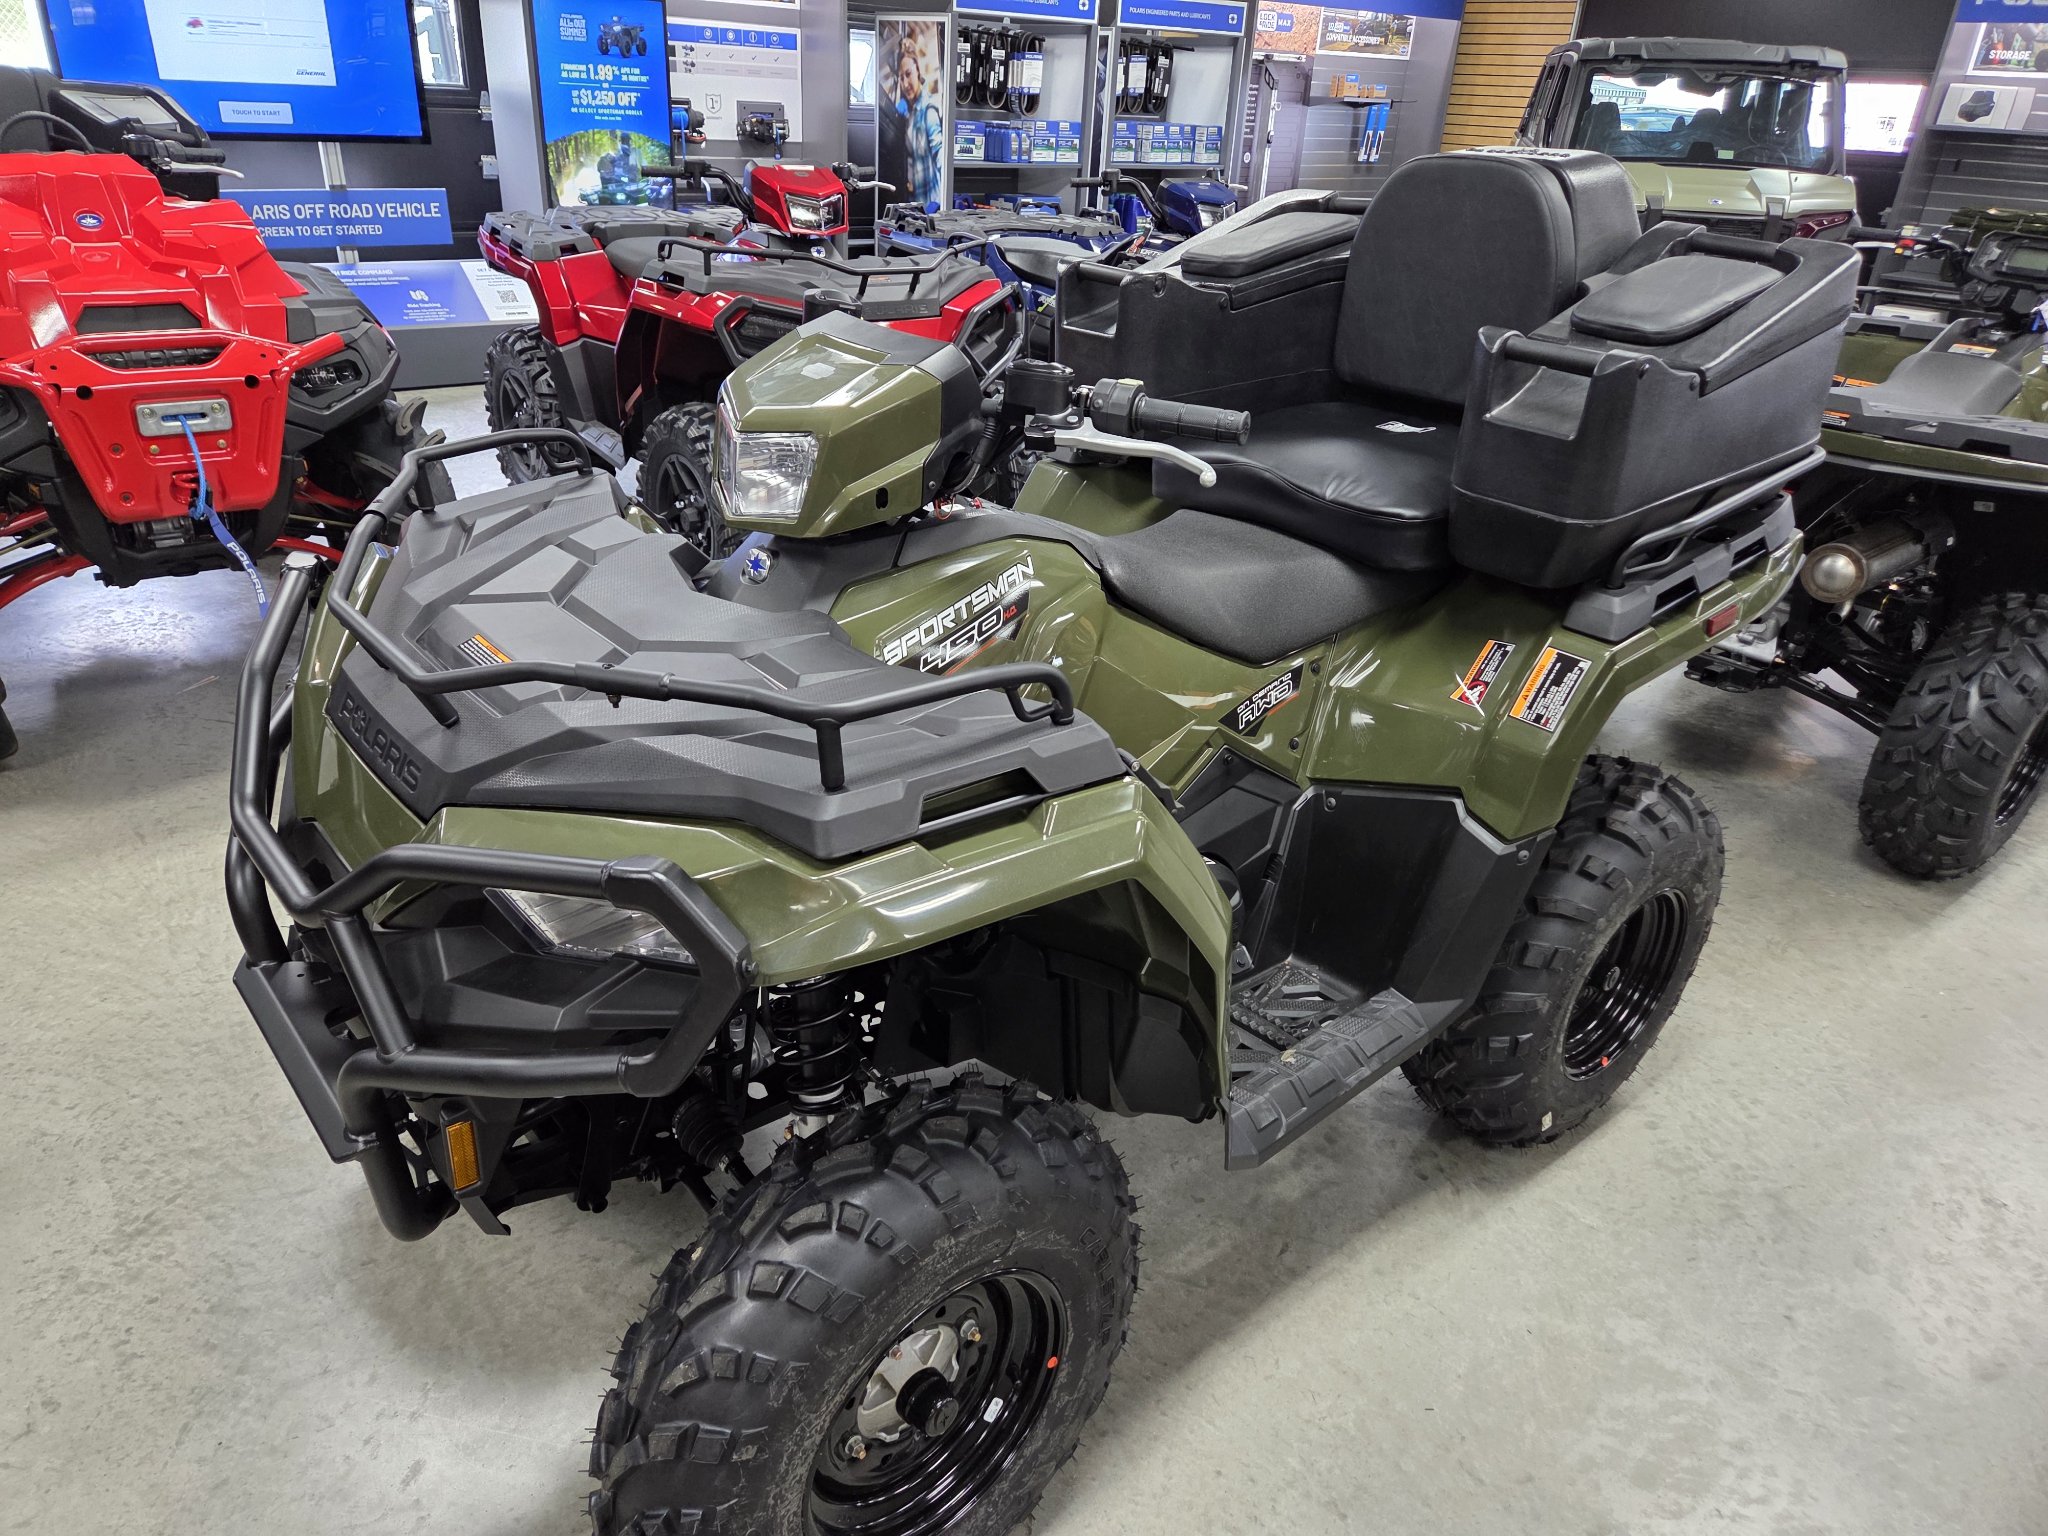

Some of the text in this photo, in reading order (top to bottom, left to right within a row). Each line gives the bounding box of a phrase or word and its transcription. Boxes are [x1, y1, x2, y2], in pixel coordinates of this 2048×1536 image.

[1129, 6, 1146, 14] POLARIS
[1259, 12, 1276, 21] LOCK
[559, 27, 587, 37] SUMMER
[1277, 18, 1292, 27] MAX
[1325, 32, 1381, 45] COMPATIBLE ACCESSORIES
[1988, 49, 2032, 60] STORAGE
[579, 88, 616, 107] $1,250
[261, 109, 281, 117] START
[249, 202, 442, 221] ARIS OFF ROAD VEHICLE
[257, 224, 383, 238] CREEN TO GET STARTED
[226, 541, 266, 604] POLARIS
[882, 554, 1035, 666] SPORTSMAN
[919, 604, 1004, 673] 450
[1465, 654, 1485, 683] WARNING
[1252, 672, 1292, 701] DEMAND
[1527, 663, 1546, 697] WARNING
[1238, 680, 1293, 730] AWD
[338, 692, 423, 794] POLARIS
